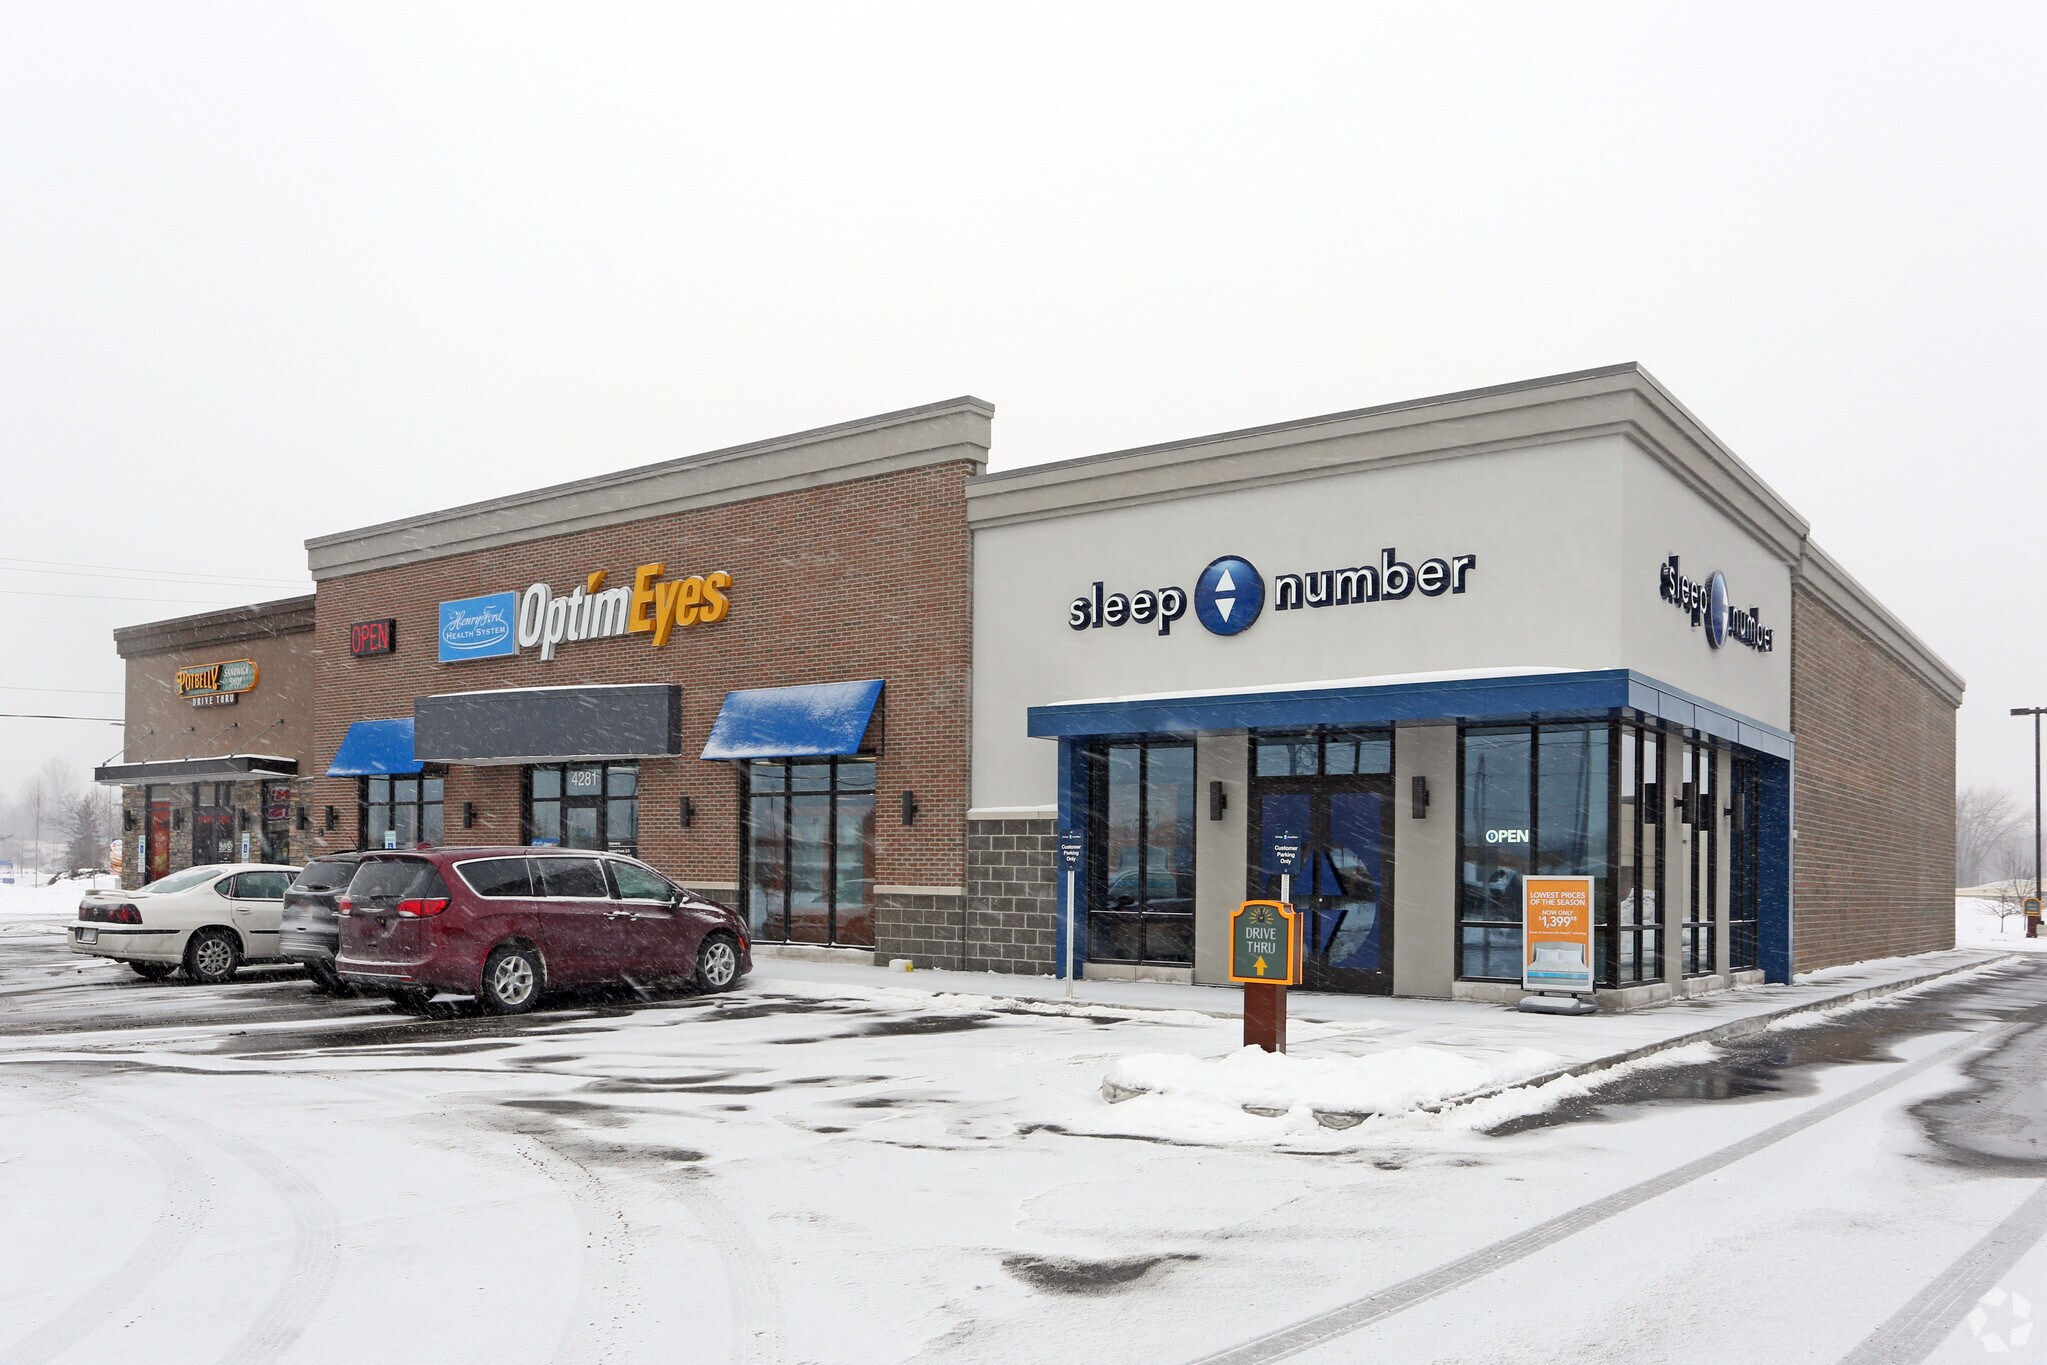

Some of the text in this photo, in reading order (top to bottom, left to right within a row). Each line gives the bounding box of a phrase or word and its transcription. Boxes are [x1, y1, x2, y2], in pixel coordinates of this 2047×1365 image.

[1068, 547, 1476, 636] sleep number
[1660, 555, 1708, 627] sleep
[449, 605, 504, 630] Henry Ford
[518, 563, 732, 661] OptimEyes
[351, 622, 389, 653] OPEN
[176, 664, 249, 695] POTBELLY SANDWICH
[229, 677, 243, 686] SHOP
[192, 694, 235, 707] DRIVE THRU
[571, 771, 597, 786] 4281
[1485, 829, 1529, 843] OPEN
[1245, 927, 1277, 940] DRIVE
[1246, 941, 1276, 954] THRU
